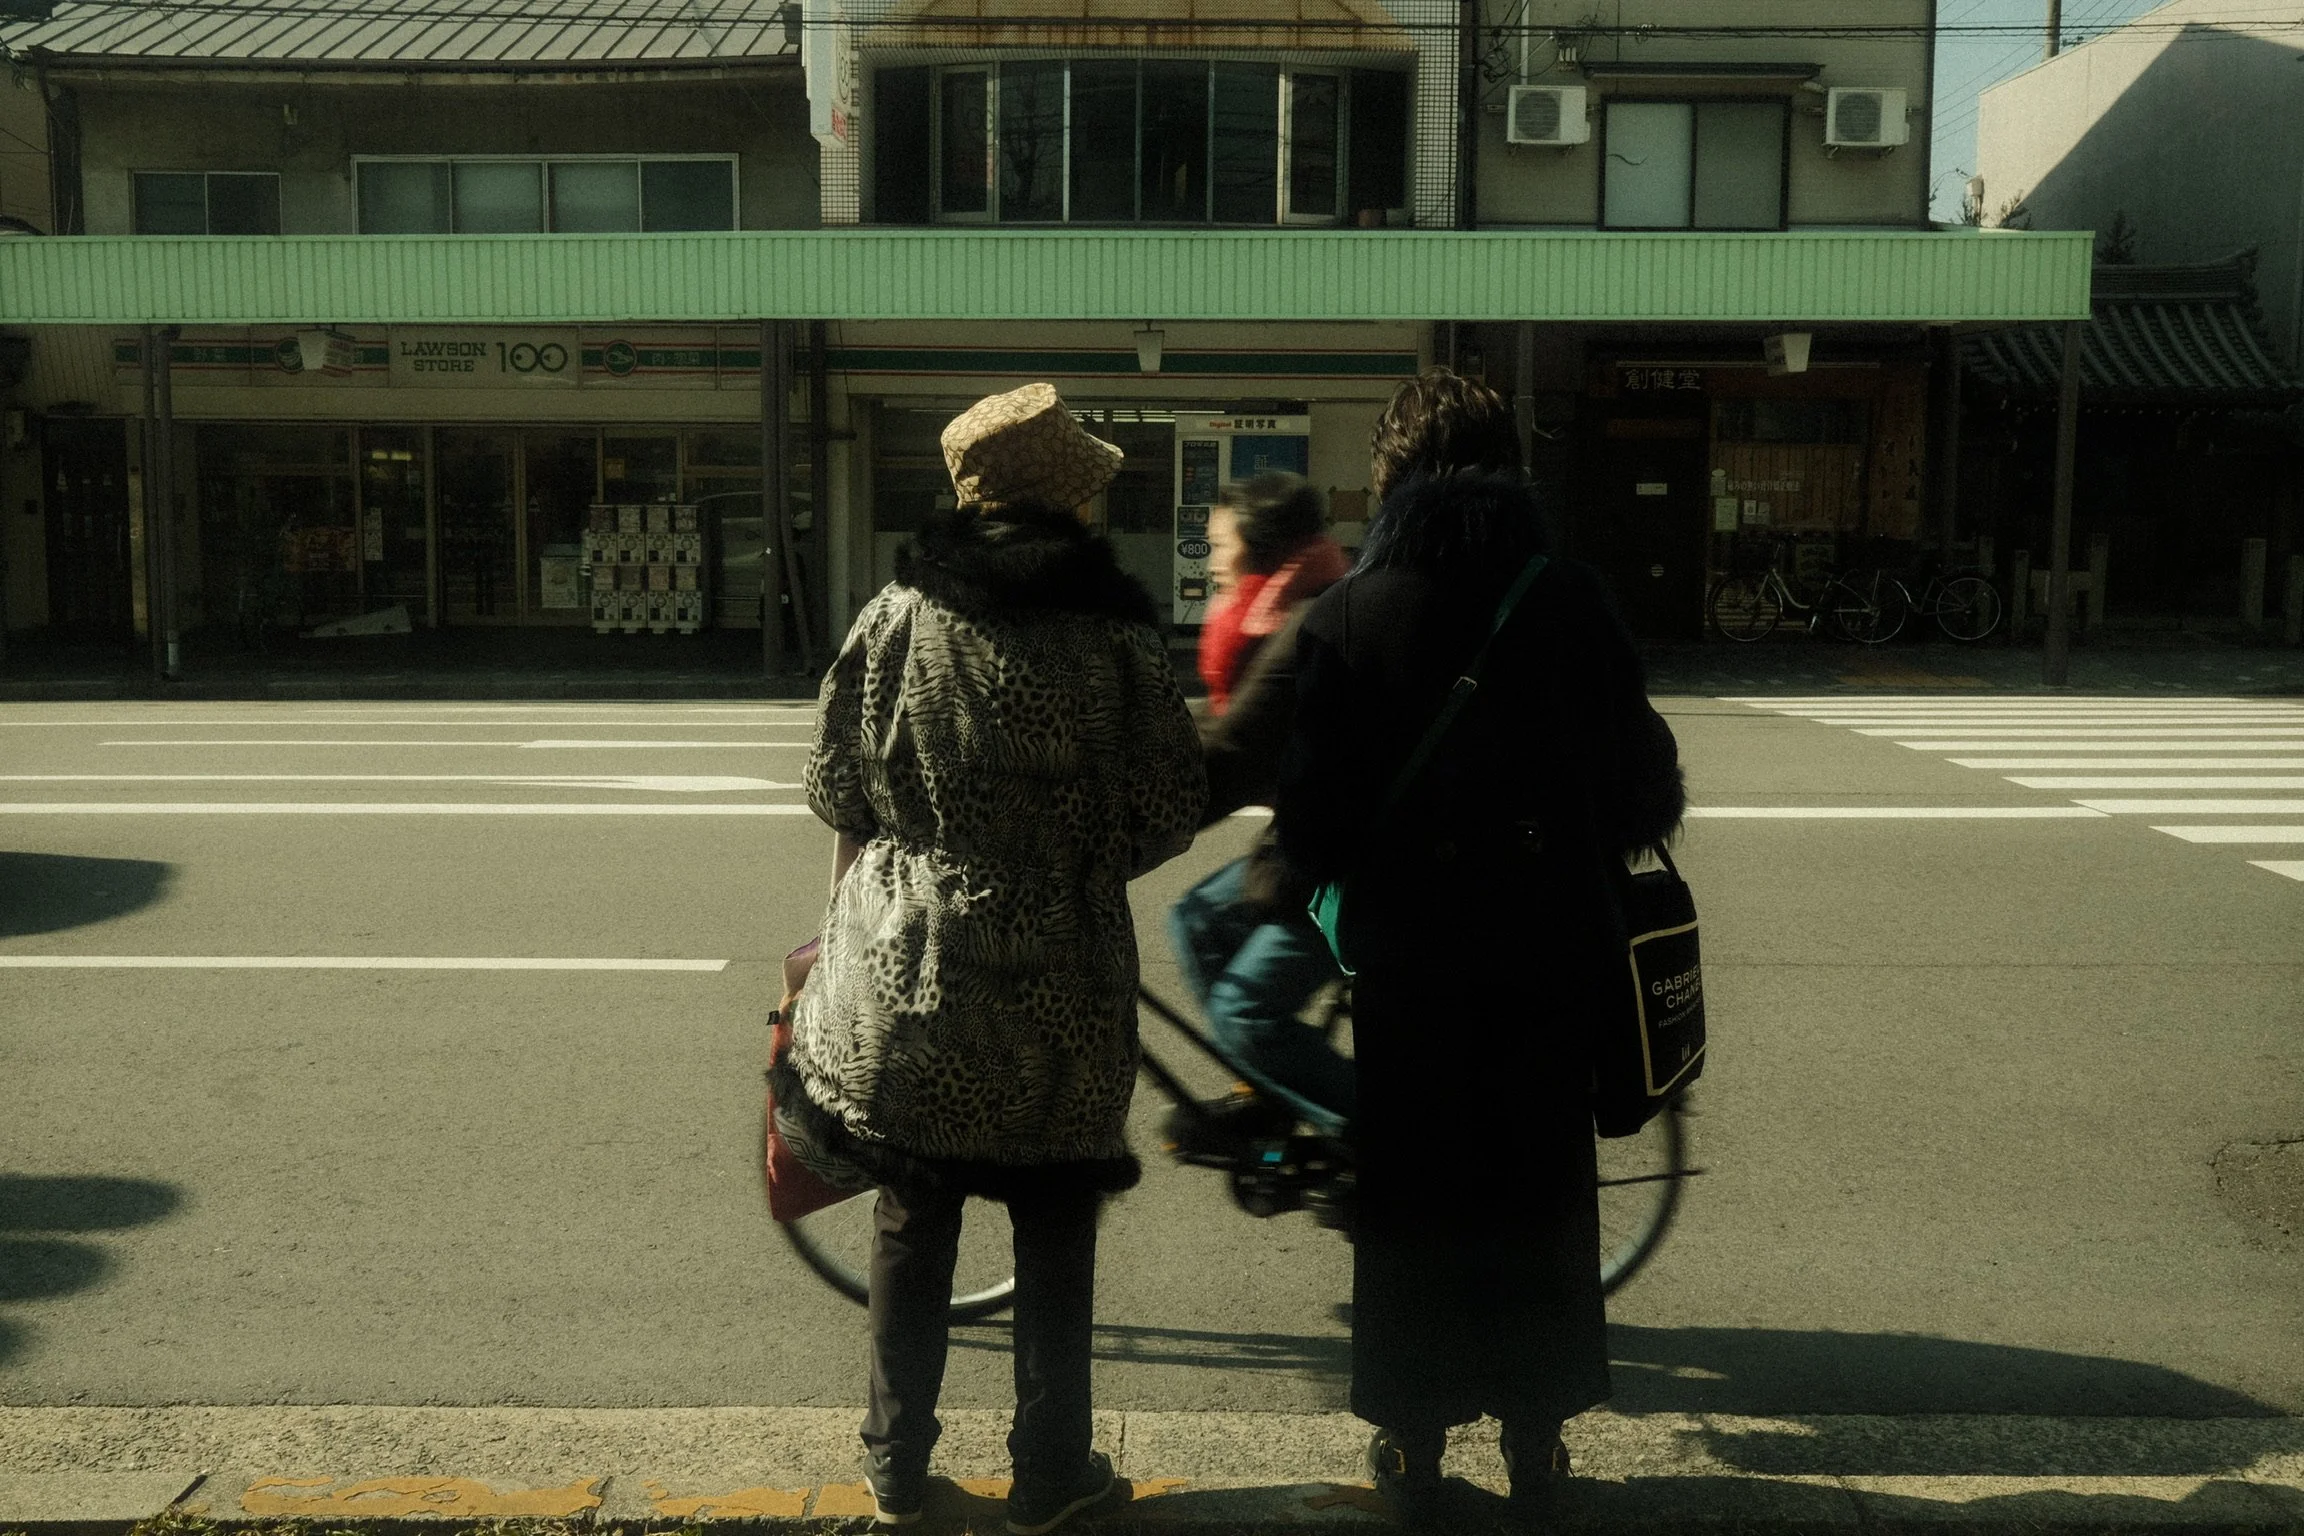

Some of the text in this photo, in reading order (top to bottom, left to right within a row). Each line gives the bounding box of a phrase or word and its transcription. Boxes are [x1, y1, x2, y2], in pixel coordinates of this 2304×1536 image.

[401, 341, 487, 356] LAWSON
[496, 341, 568, 373] 100
[413, 359, 474, 372] STORE
[1625, 368, 1701, 390] 創健堂
[1234, 419, 1276, 429] 証明写真
[1181, 543, 1208, 555] ¥800
